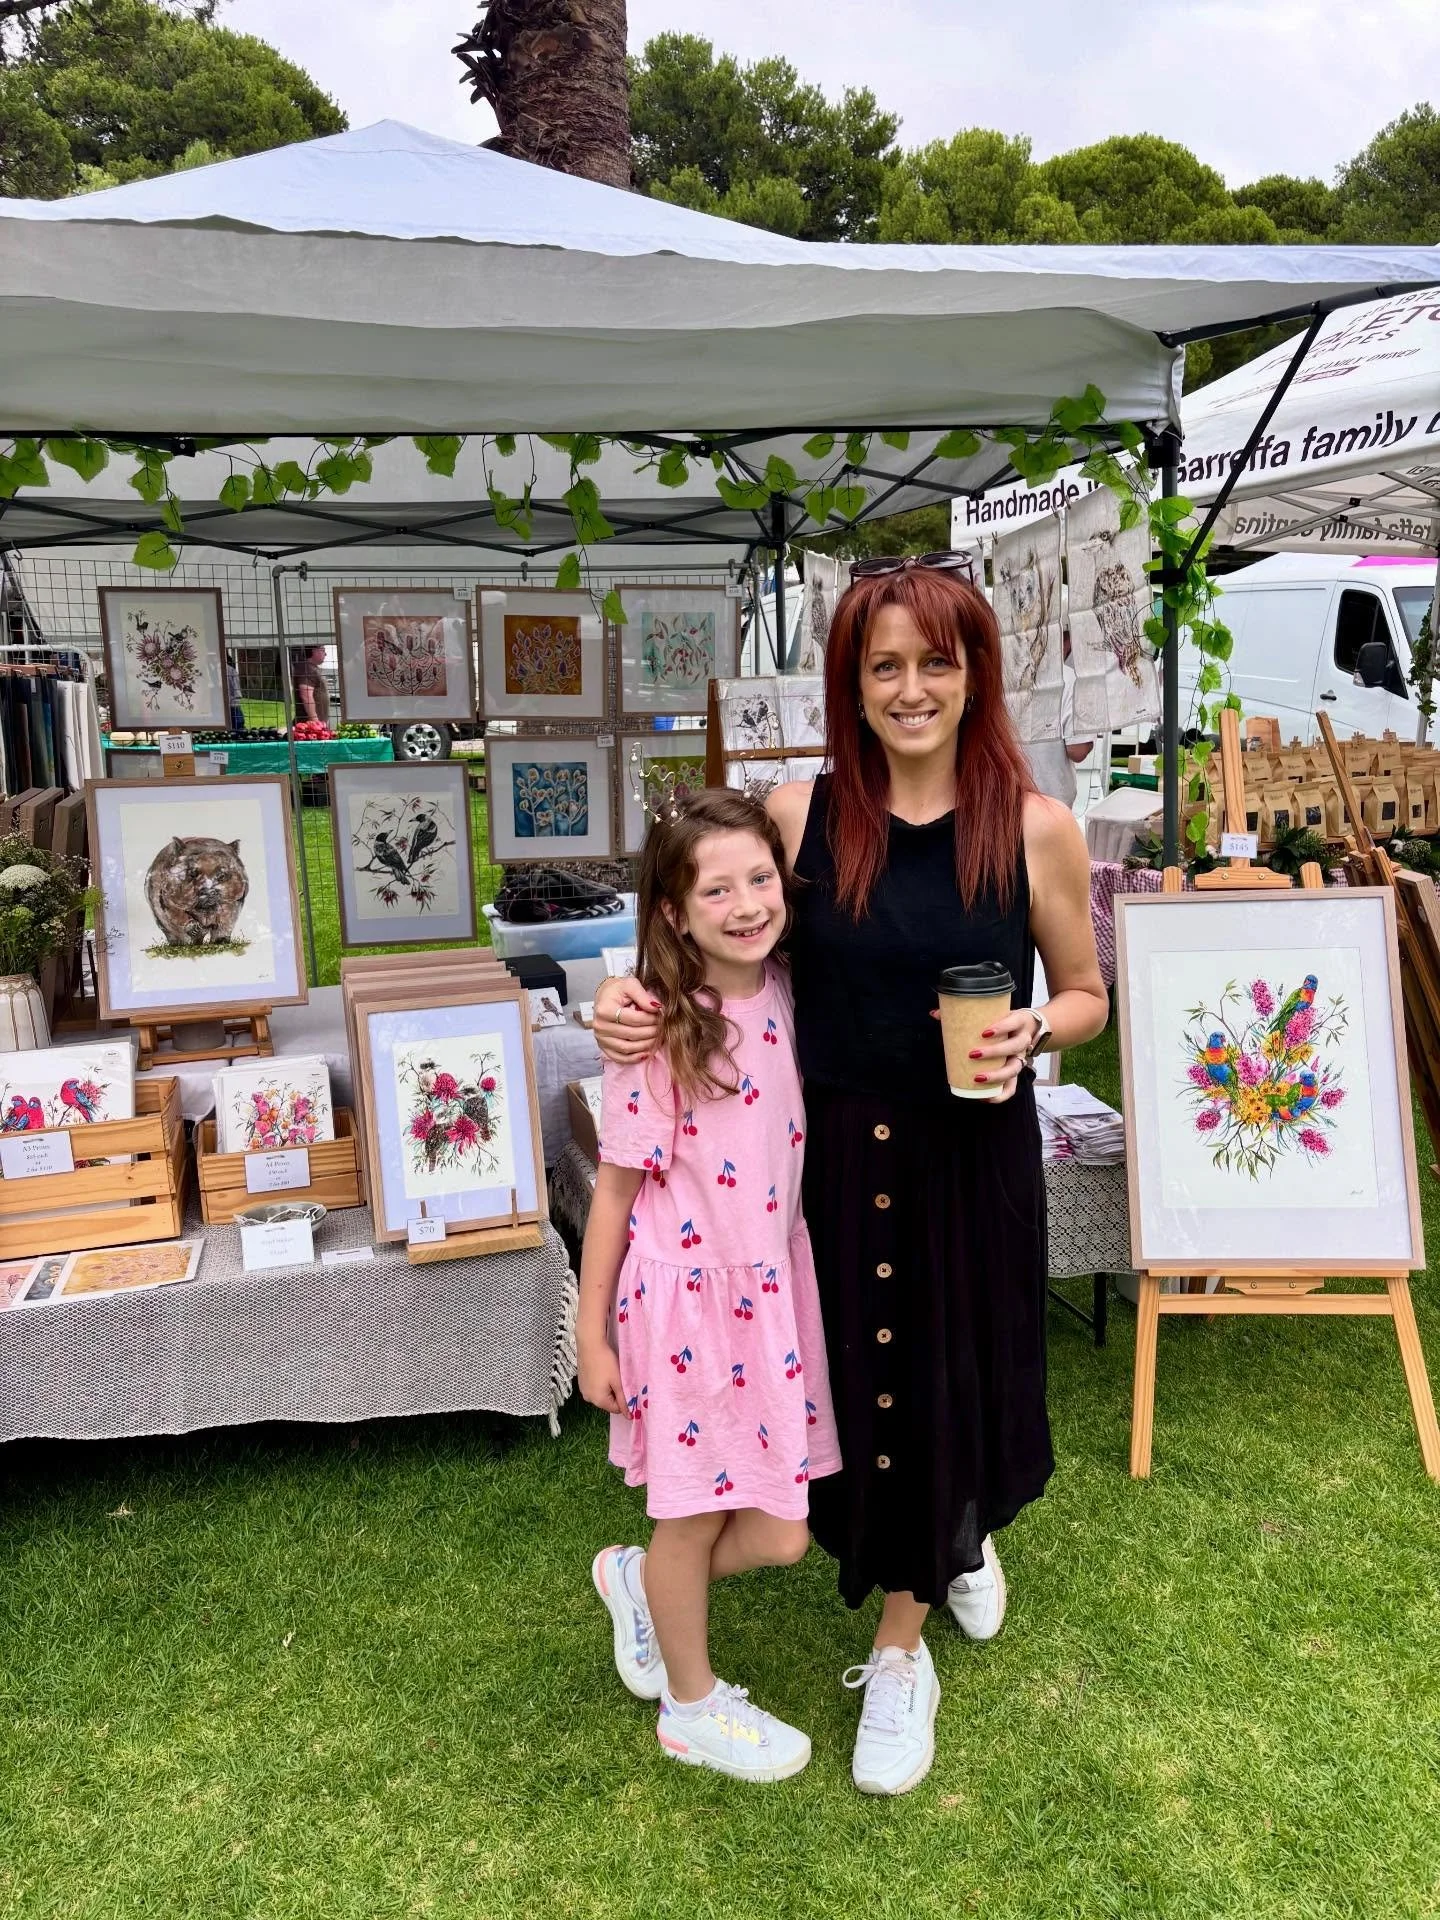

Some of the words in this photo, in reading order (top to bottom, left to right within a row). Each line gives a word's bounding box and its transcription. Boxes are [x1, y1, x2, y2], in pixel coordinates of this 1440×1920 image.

[1300, 410, 1419, 462] family
[966, 479, 1080, 526] Handmade
[167, 741, 185, 750] $110
